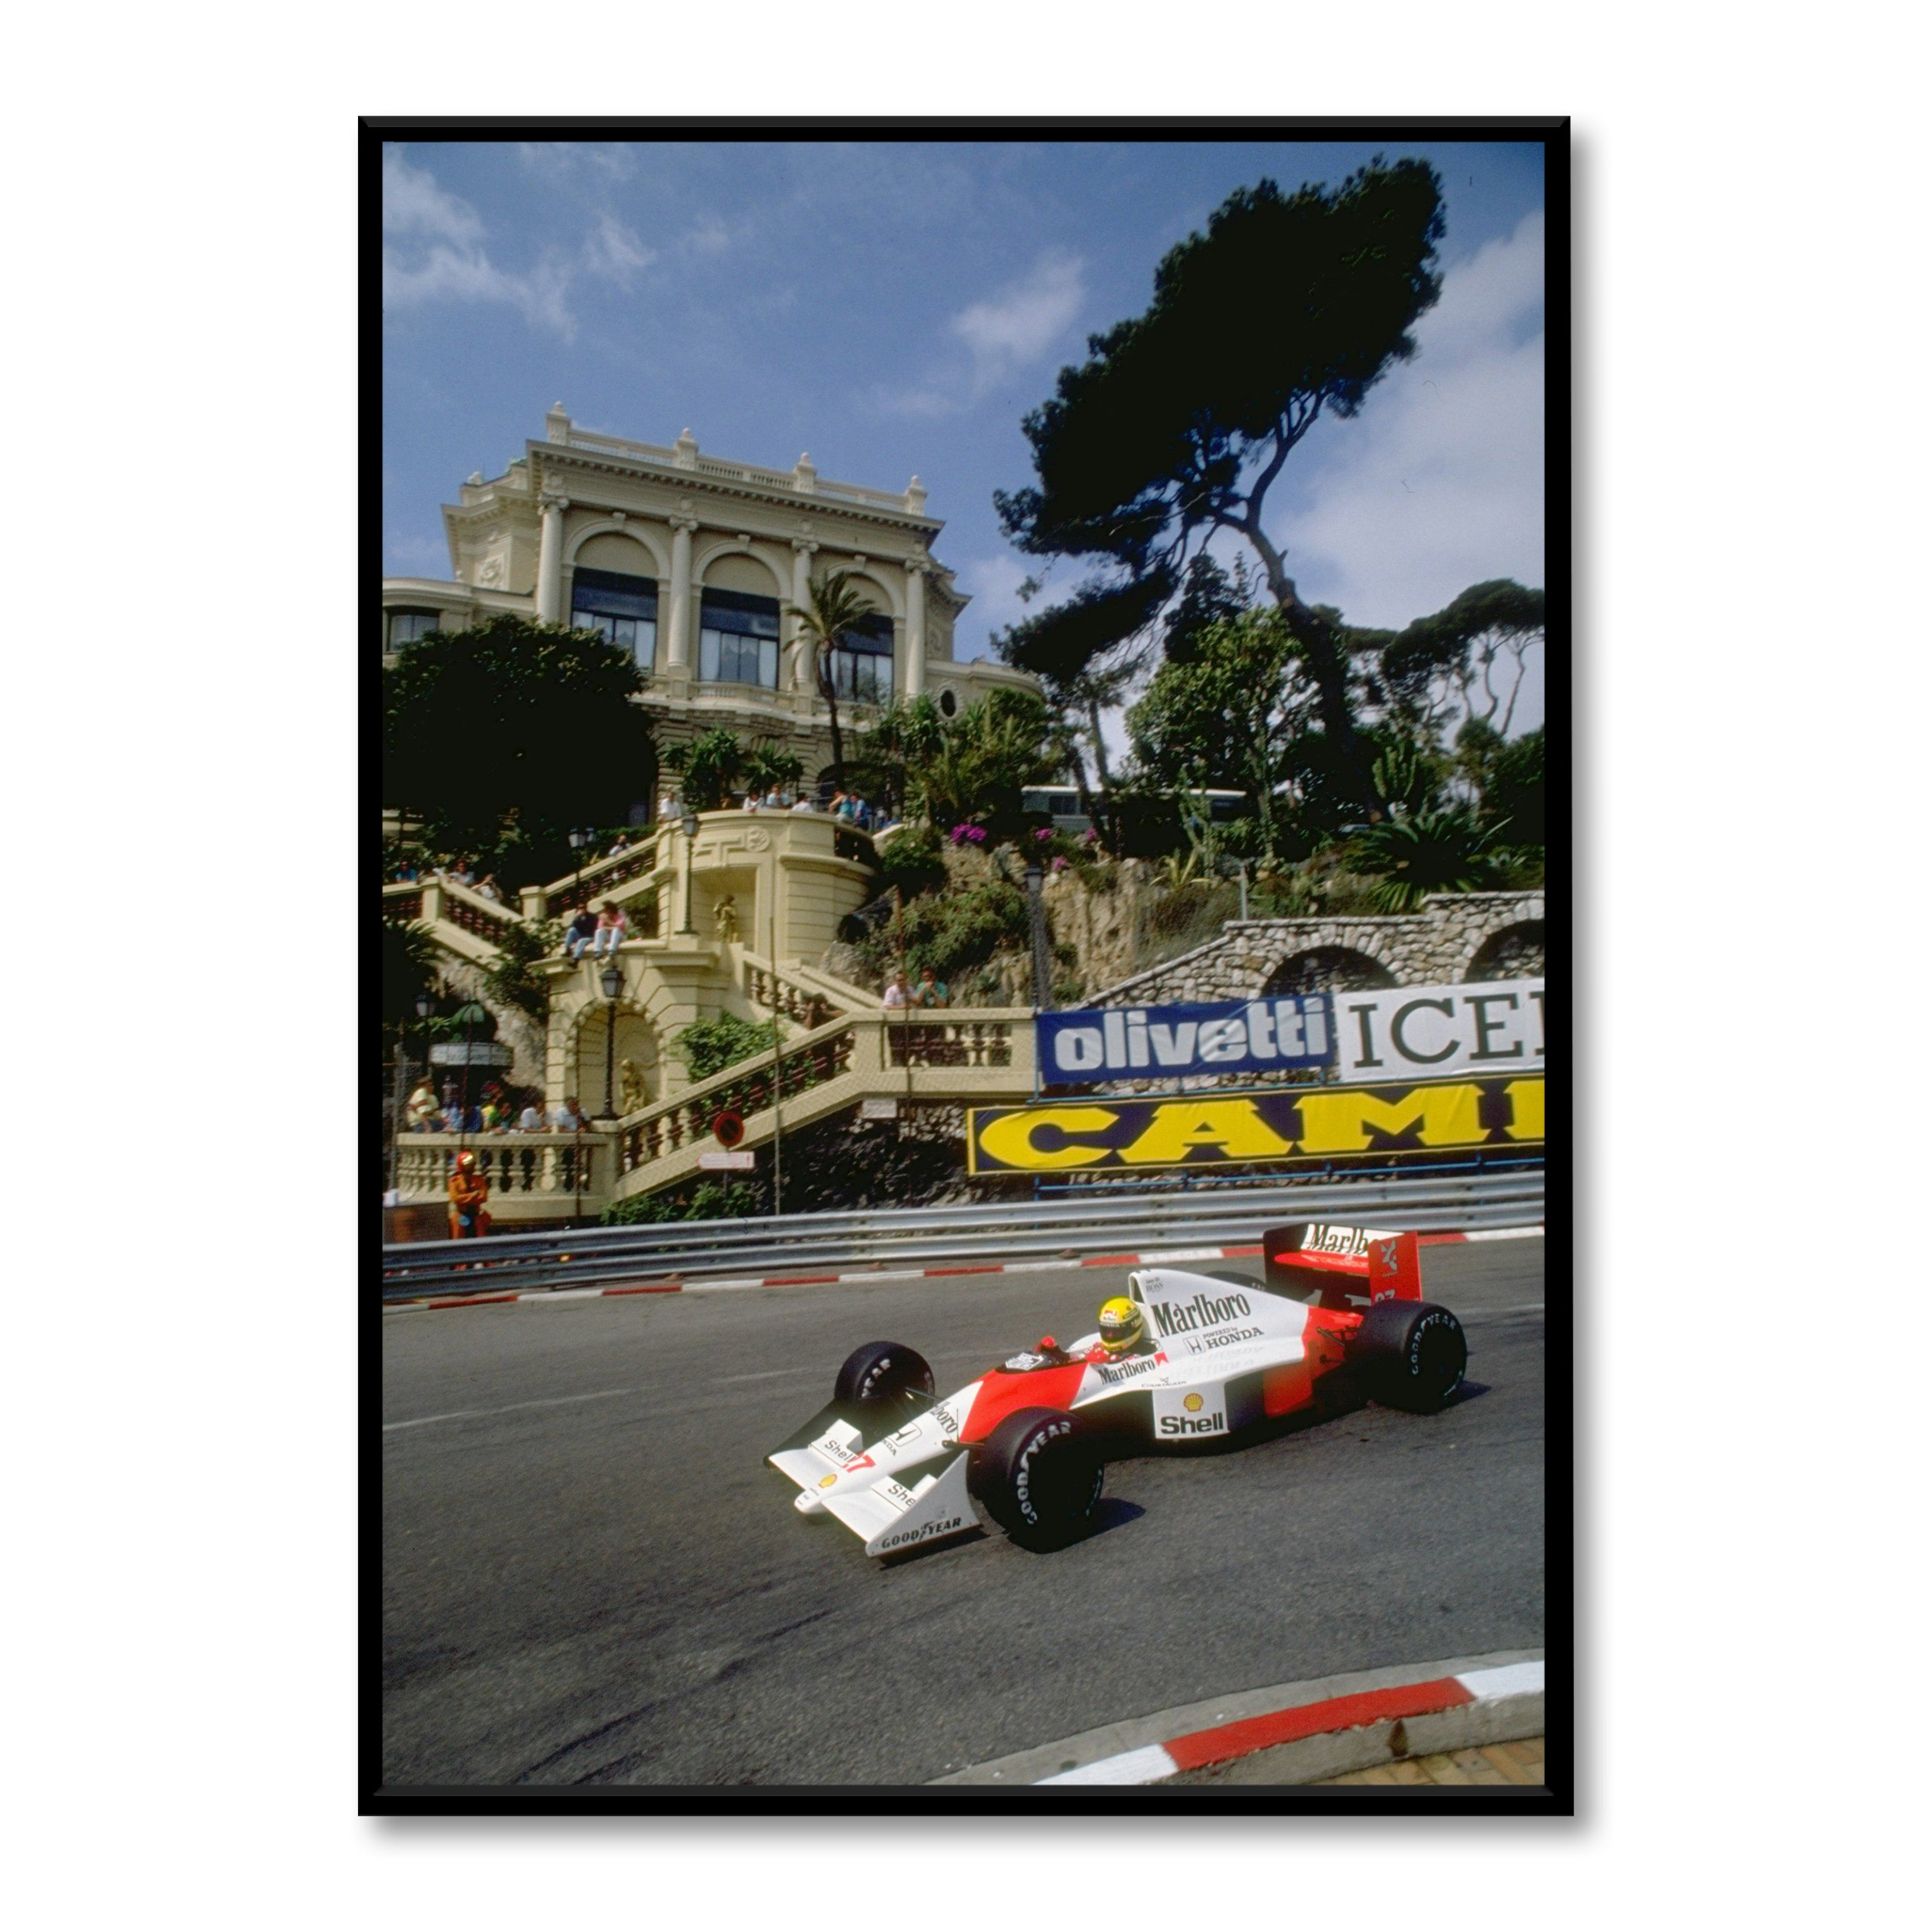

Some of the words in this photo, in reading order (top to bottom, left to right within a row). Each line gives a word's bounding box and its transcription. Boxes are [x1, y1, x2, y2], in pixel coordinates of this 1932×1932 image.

[1054, 998, 1327, 1071] olivetti
[1308, 1224, 1368, 1254] Marlb
[1151, 1293, 1251, 1337] Marlboro
[1203, 1327, 1231, 1339] POWERED
[1205, 1327, 1265, 1349] HONDA
[1097, 1359, 1156, 1385] Marlboro
[1161, 1412, 1224, 1434] Shell
[825, 1440, 859, 1463] Shell
[888, 1484, 916, 1507] She
[881, 1517, 961, 1548] GOODYEAR
